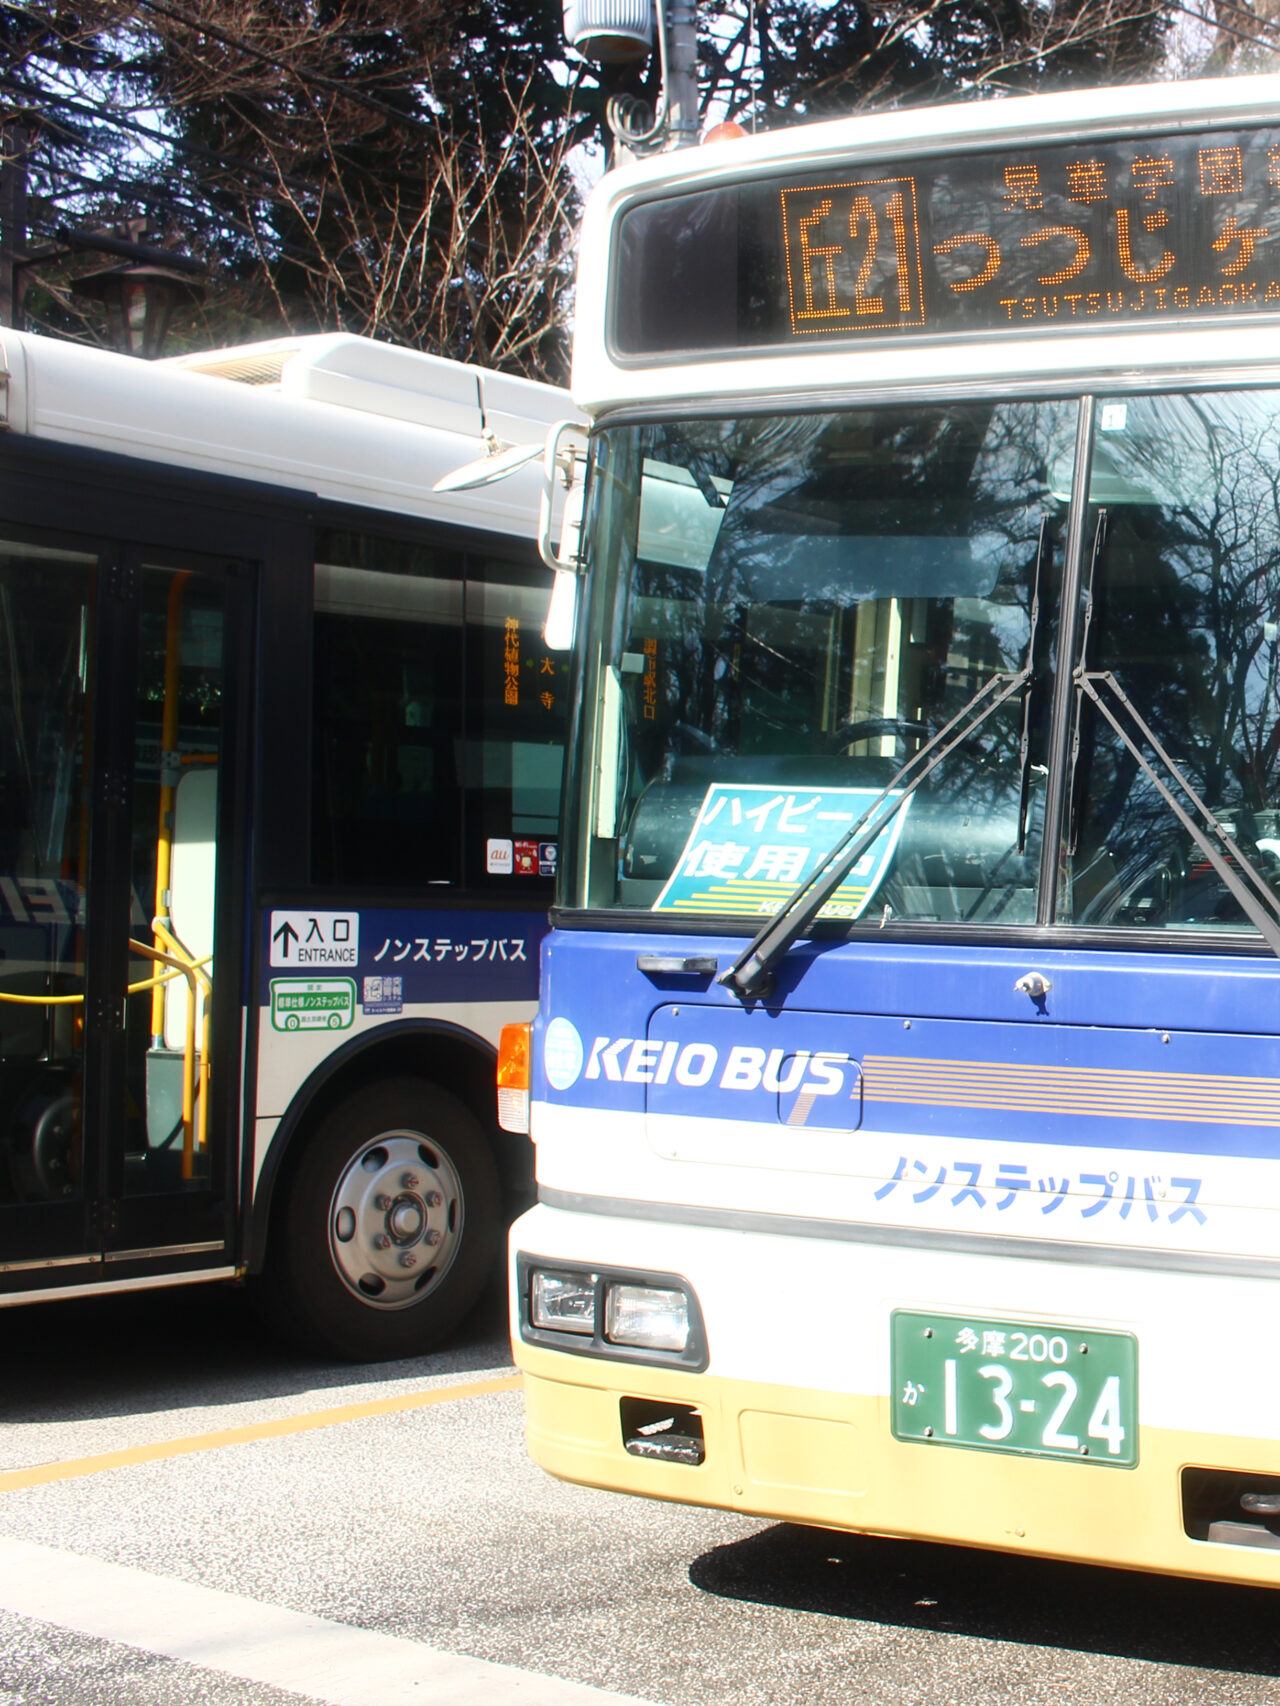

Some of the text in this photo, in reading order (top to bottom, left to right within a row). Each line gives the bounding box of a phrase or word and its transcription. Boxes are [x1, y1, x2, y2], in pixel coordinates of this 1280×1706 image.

[796, 193, 912, 319] 丘21
[298, 948, 356, 962] ENTRANCE
[305, 918, 350, 943] 入口
[374, 938, 527, 962] ノンステップバス
[584, 1036, 719, 1087] KEIO
[719, 1046, 850, 1096] BUS
[874, 1156, 1209, 1226] ノンステップバス
[902, 1359, 1125, 1455] か 13-24
